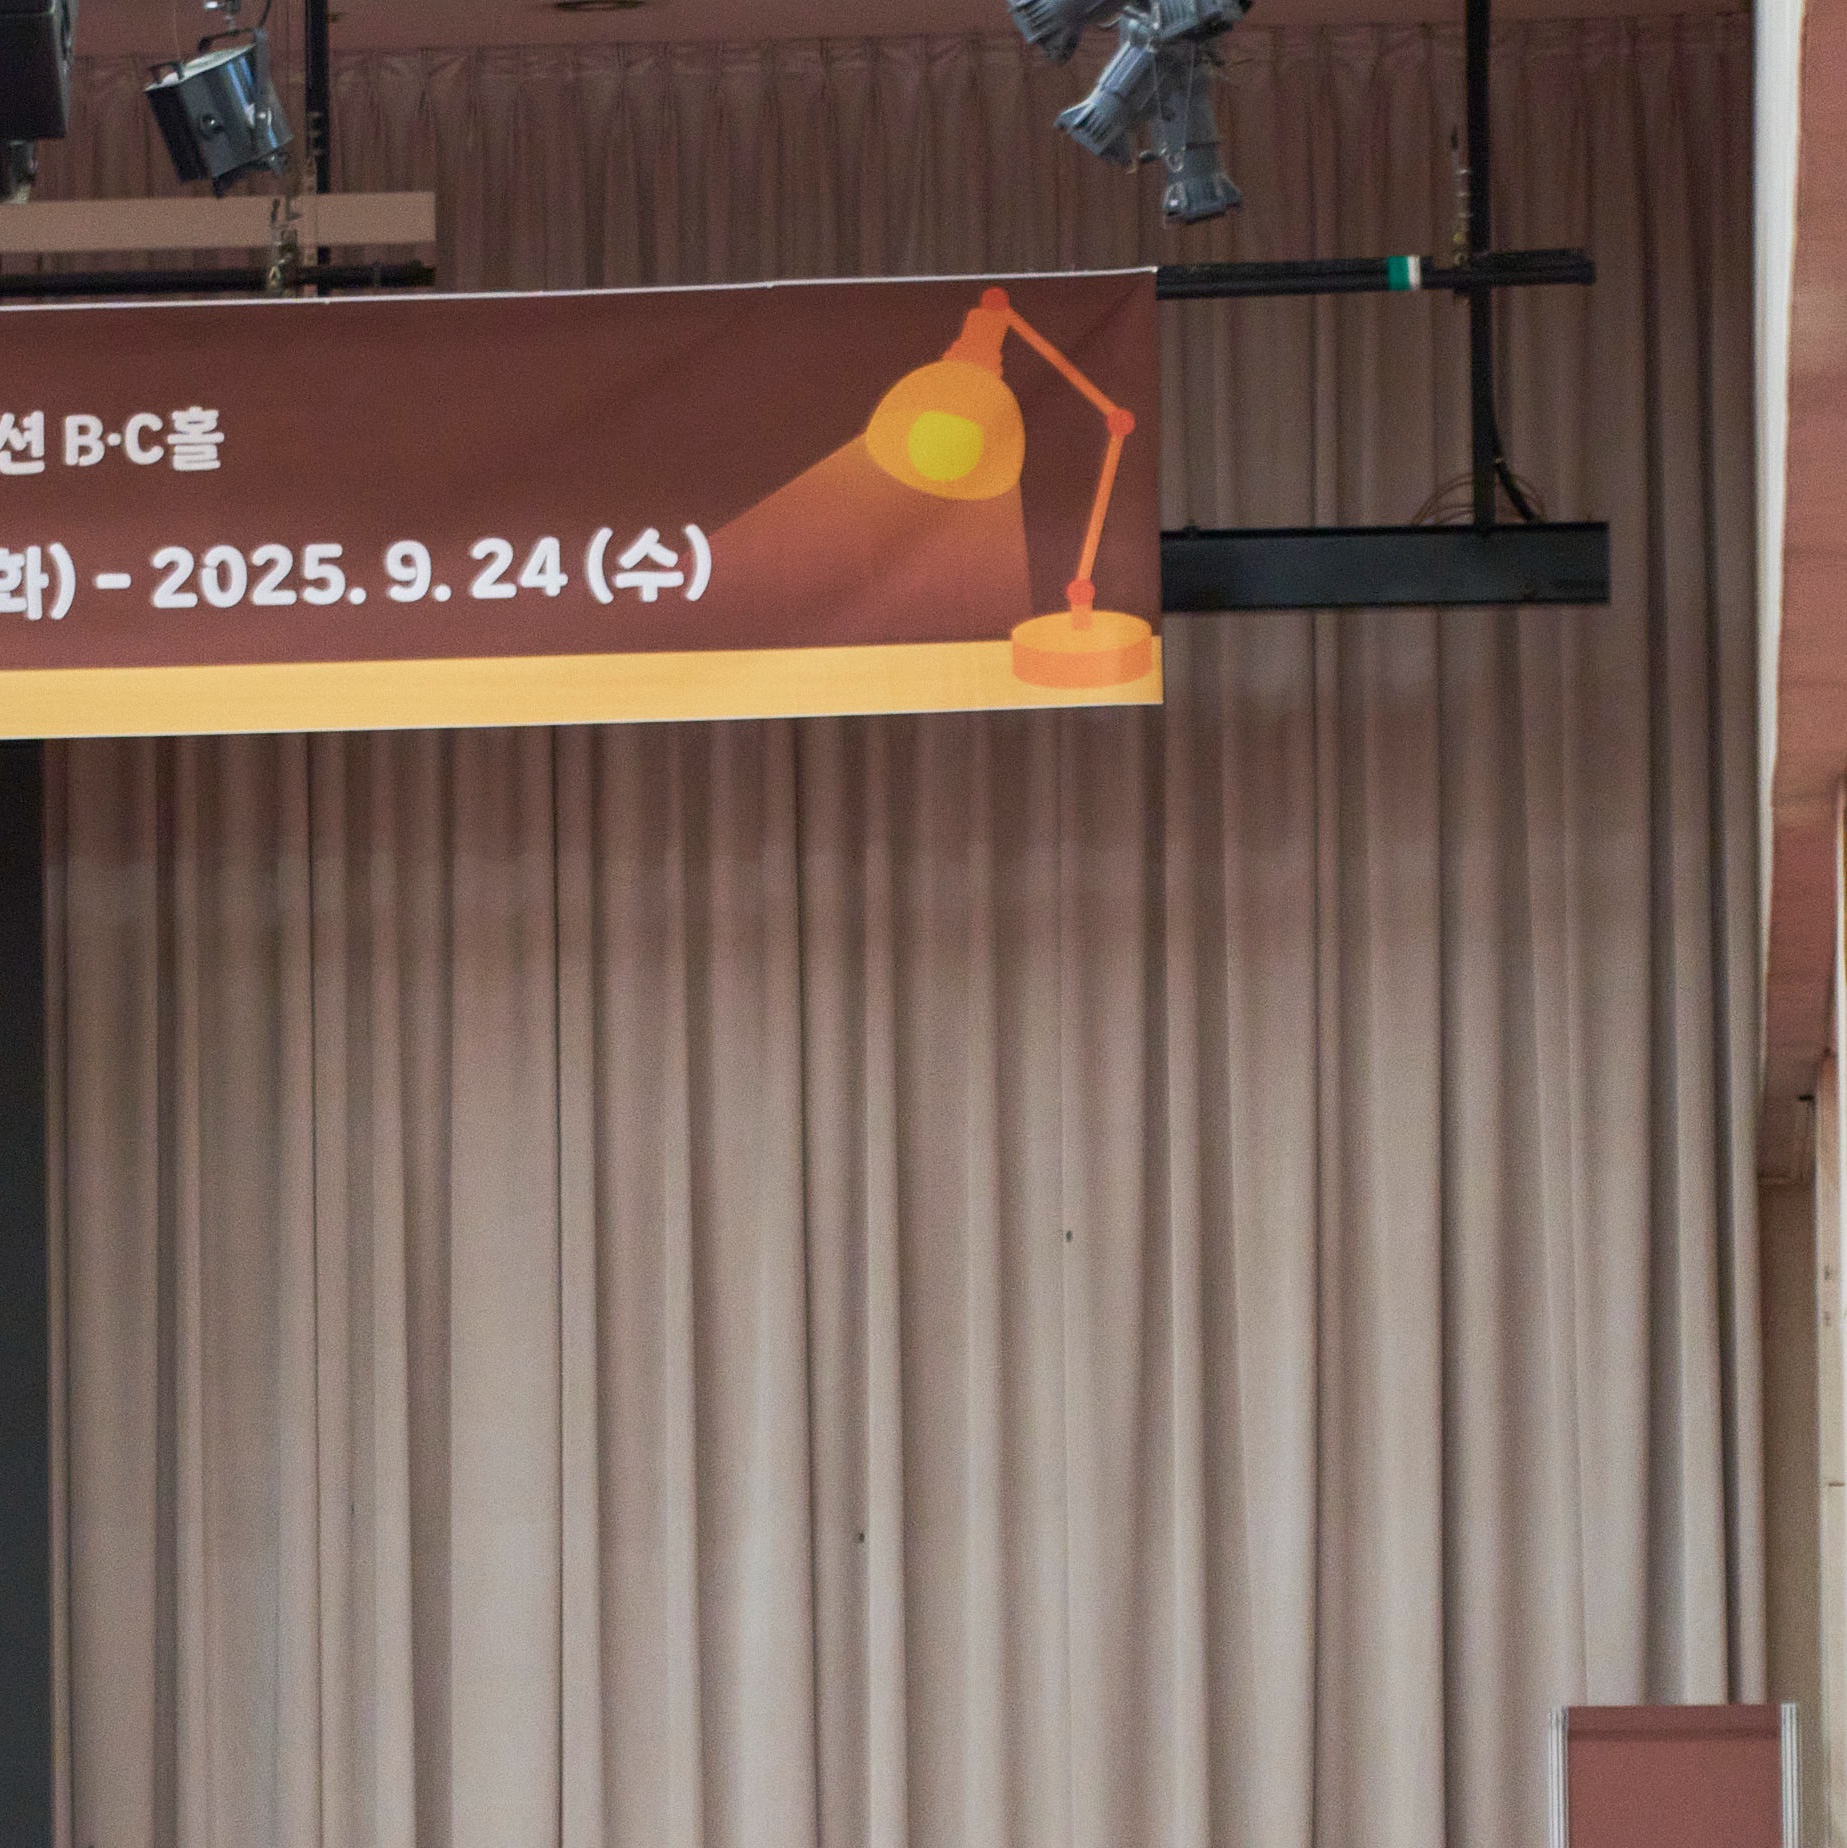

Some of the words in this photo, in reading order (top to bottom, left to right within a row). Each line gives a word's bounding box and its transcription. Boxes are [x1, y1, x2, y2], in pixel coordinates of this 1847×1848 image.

[151, 545, 366, 609] 2025.
[385, 544, 451, 604] 9.
[470, 536, 569, 600] 24
[586, 525, 713, 604] (수)
